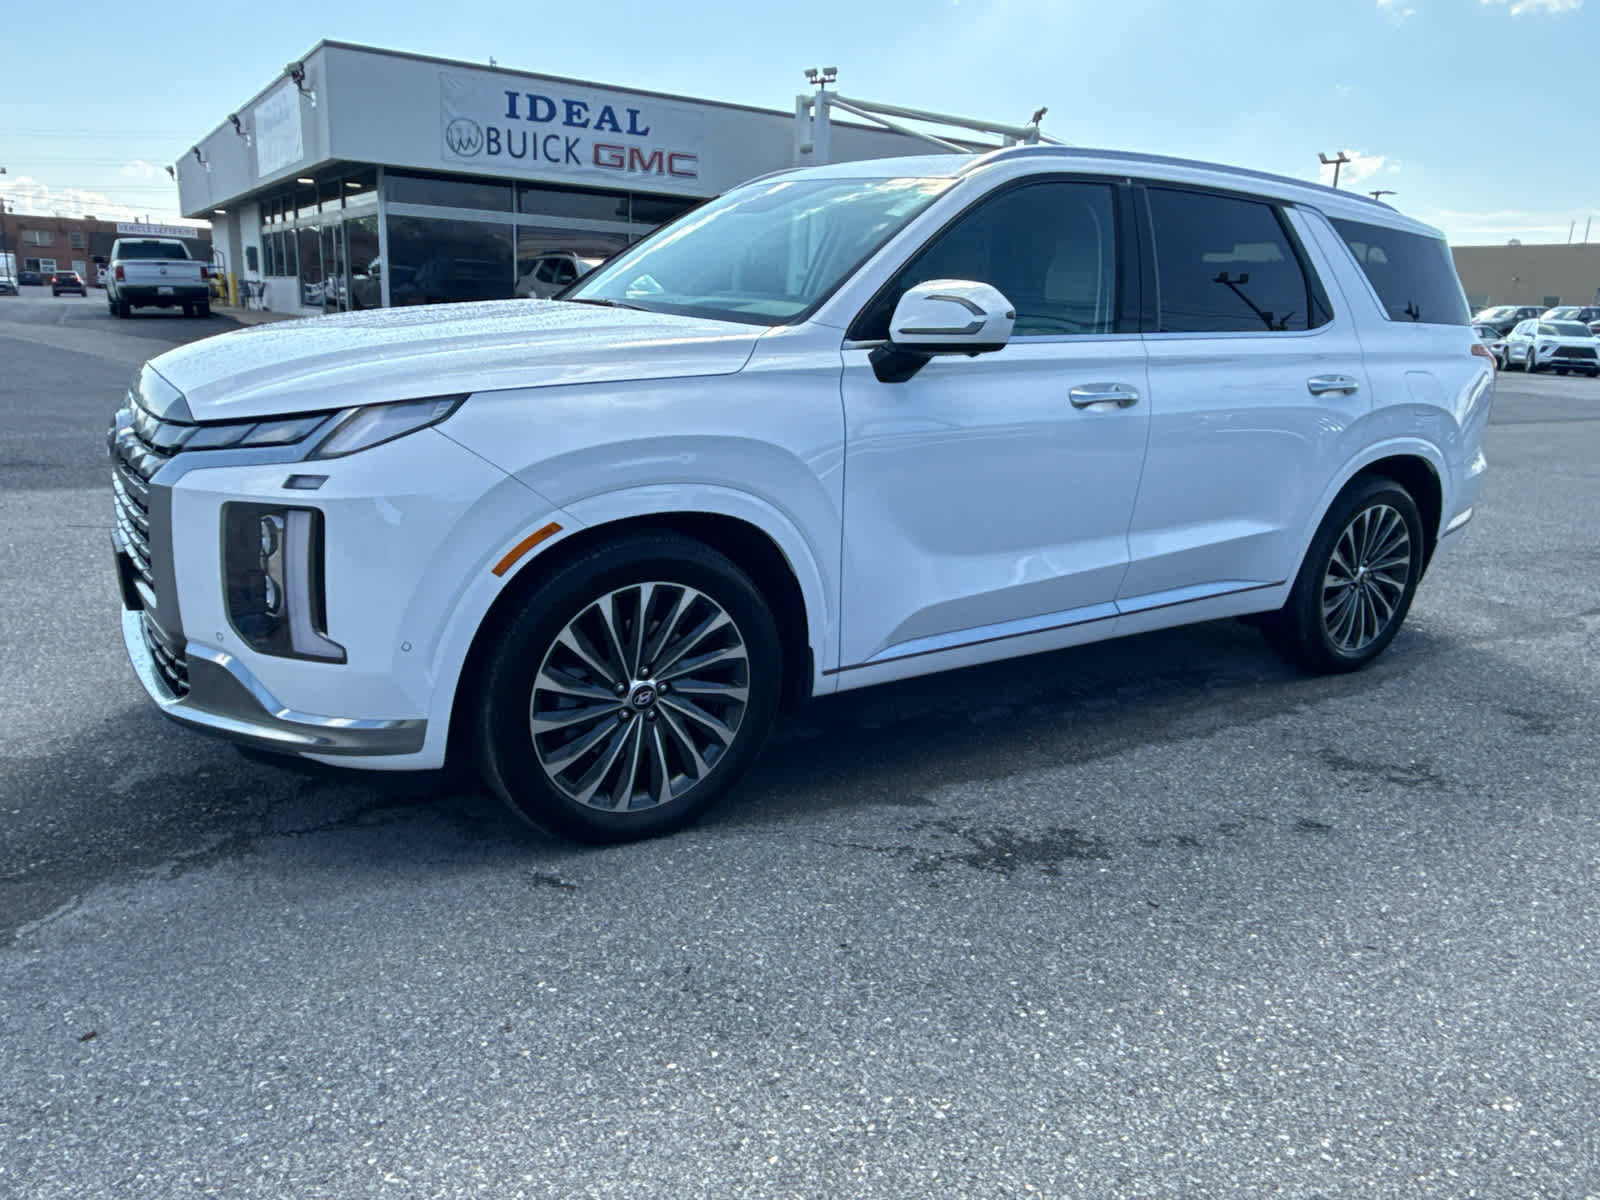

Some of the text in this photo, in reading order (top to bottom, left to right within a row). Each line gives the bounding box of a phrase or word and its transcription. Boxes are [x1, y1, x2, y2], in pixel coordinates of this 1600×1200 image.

[504, 90, 650, 136] IDEAL
[486, 126, 698, 178] BUICK GMC
